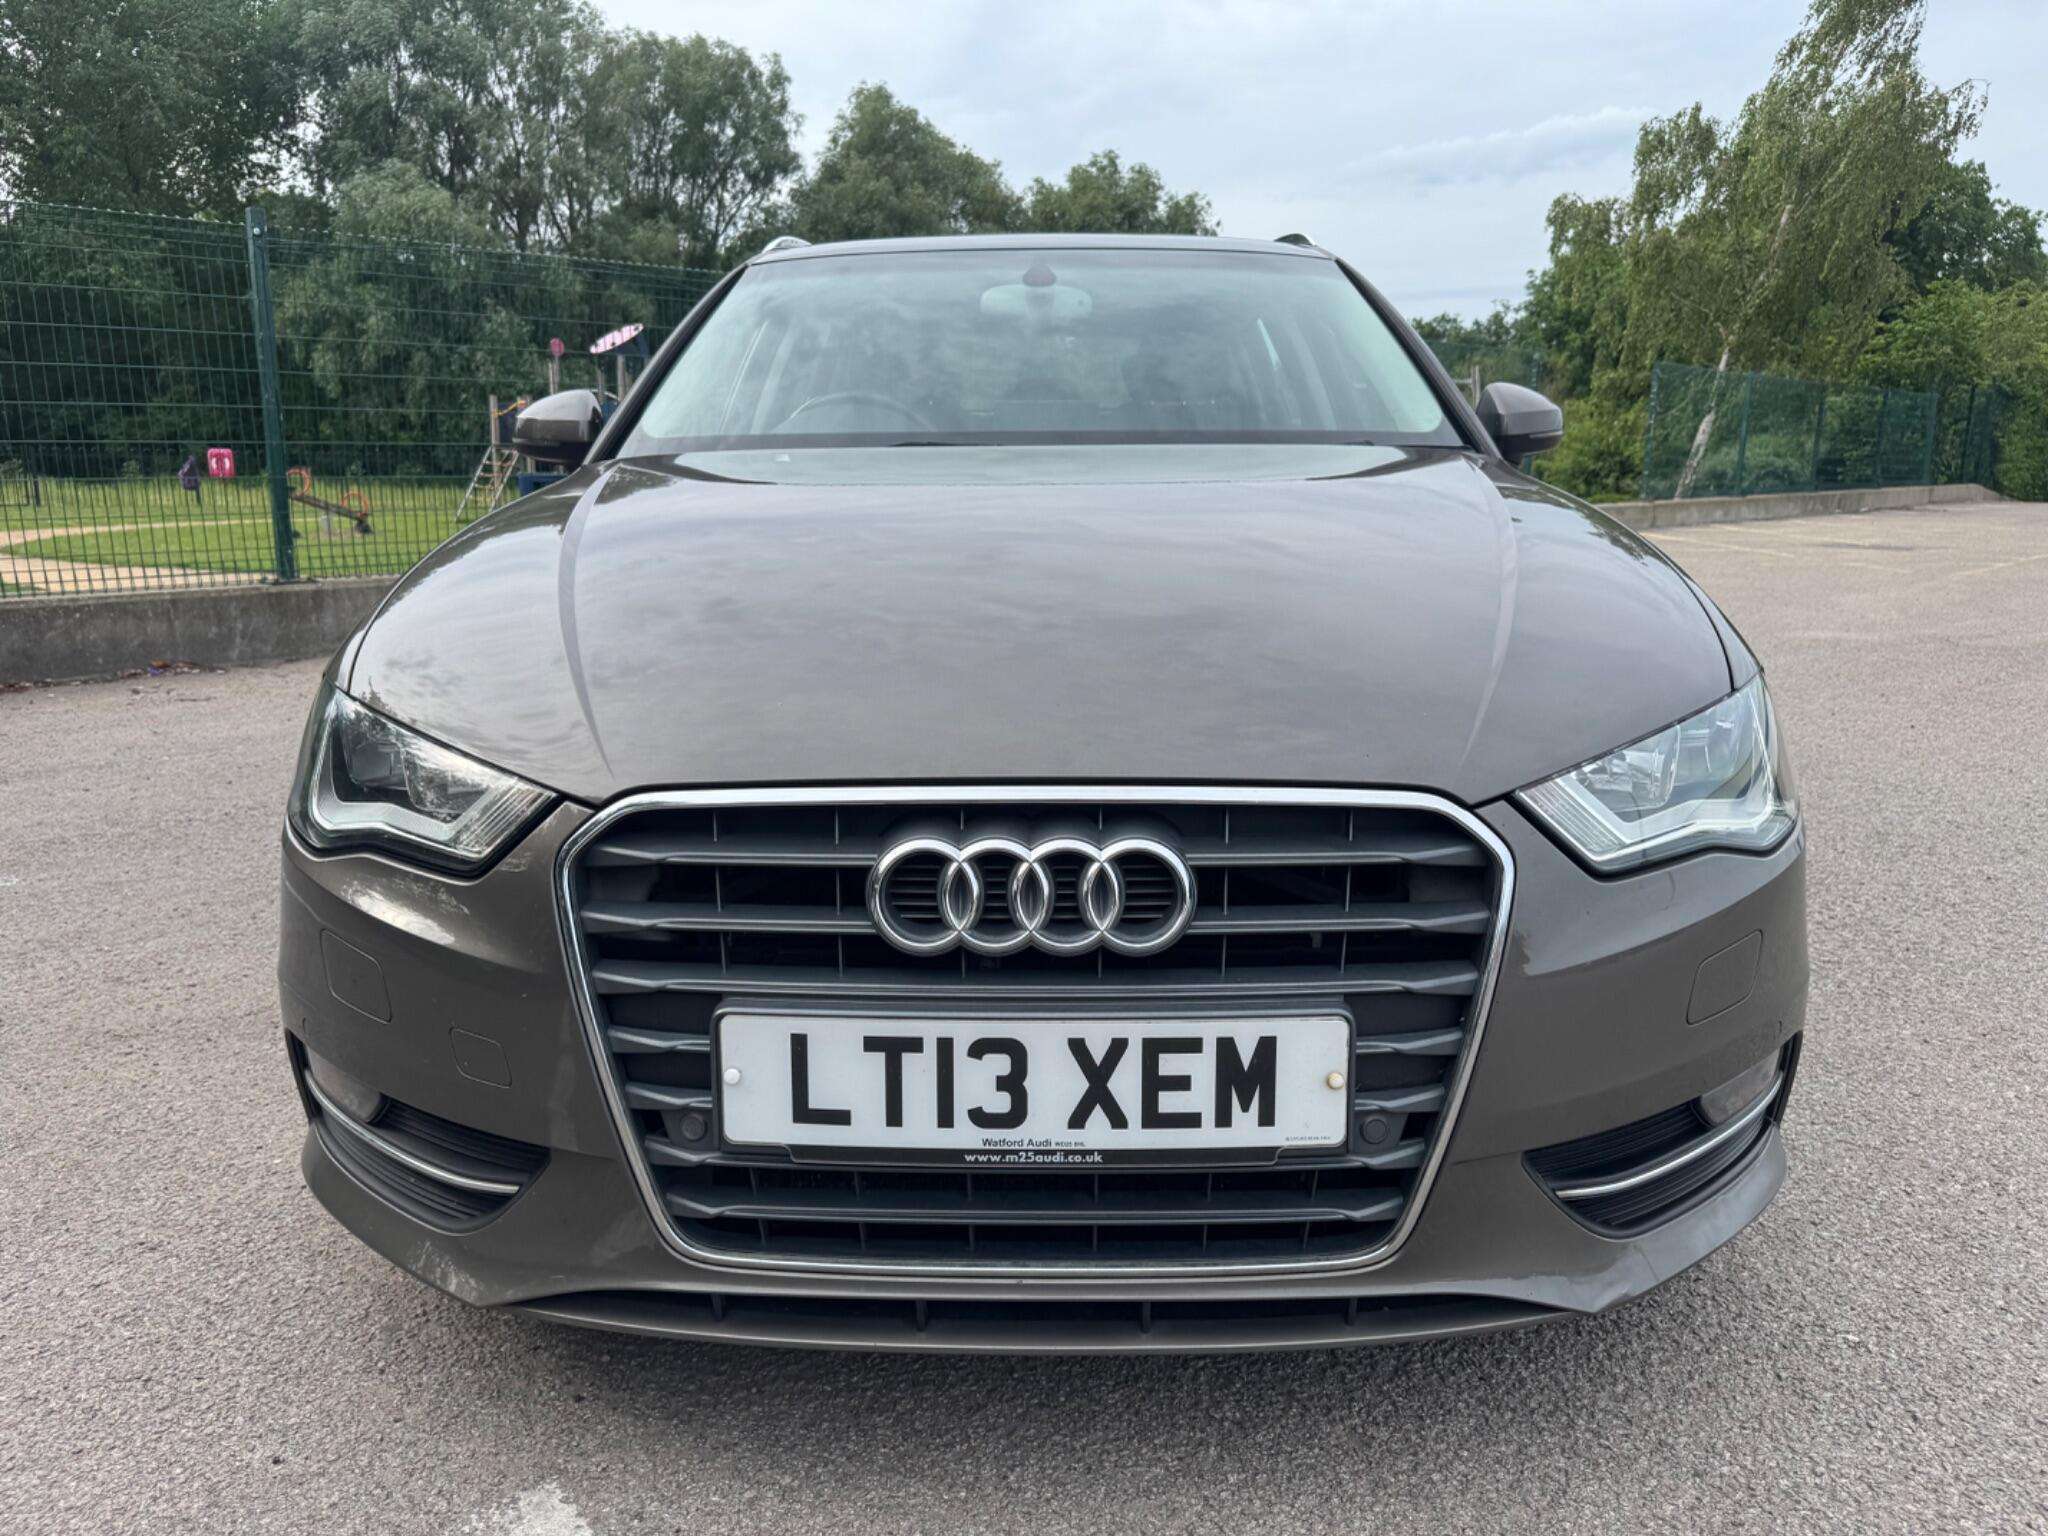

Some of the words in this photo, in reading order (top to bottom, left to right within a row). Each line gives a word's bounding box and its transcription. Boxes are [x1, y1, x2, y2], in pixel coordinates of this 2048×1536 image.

[789, 1033, 1029, 1130] LT13
[1067, 1035, 1278, 1130] XEM
[982, 1138, 1023, 1148] Watford
[1026, 1138, 1052, 1148] Audi
[964, 1151, 1103, 1163] www.m25audi.co.uk
